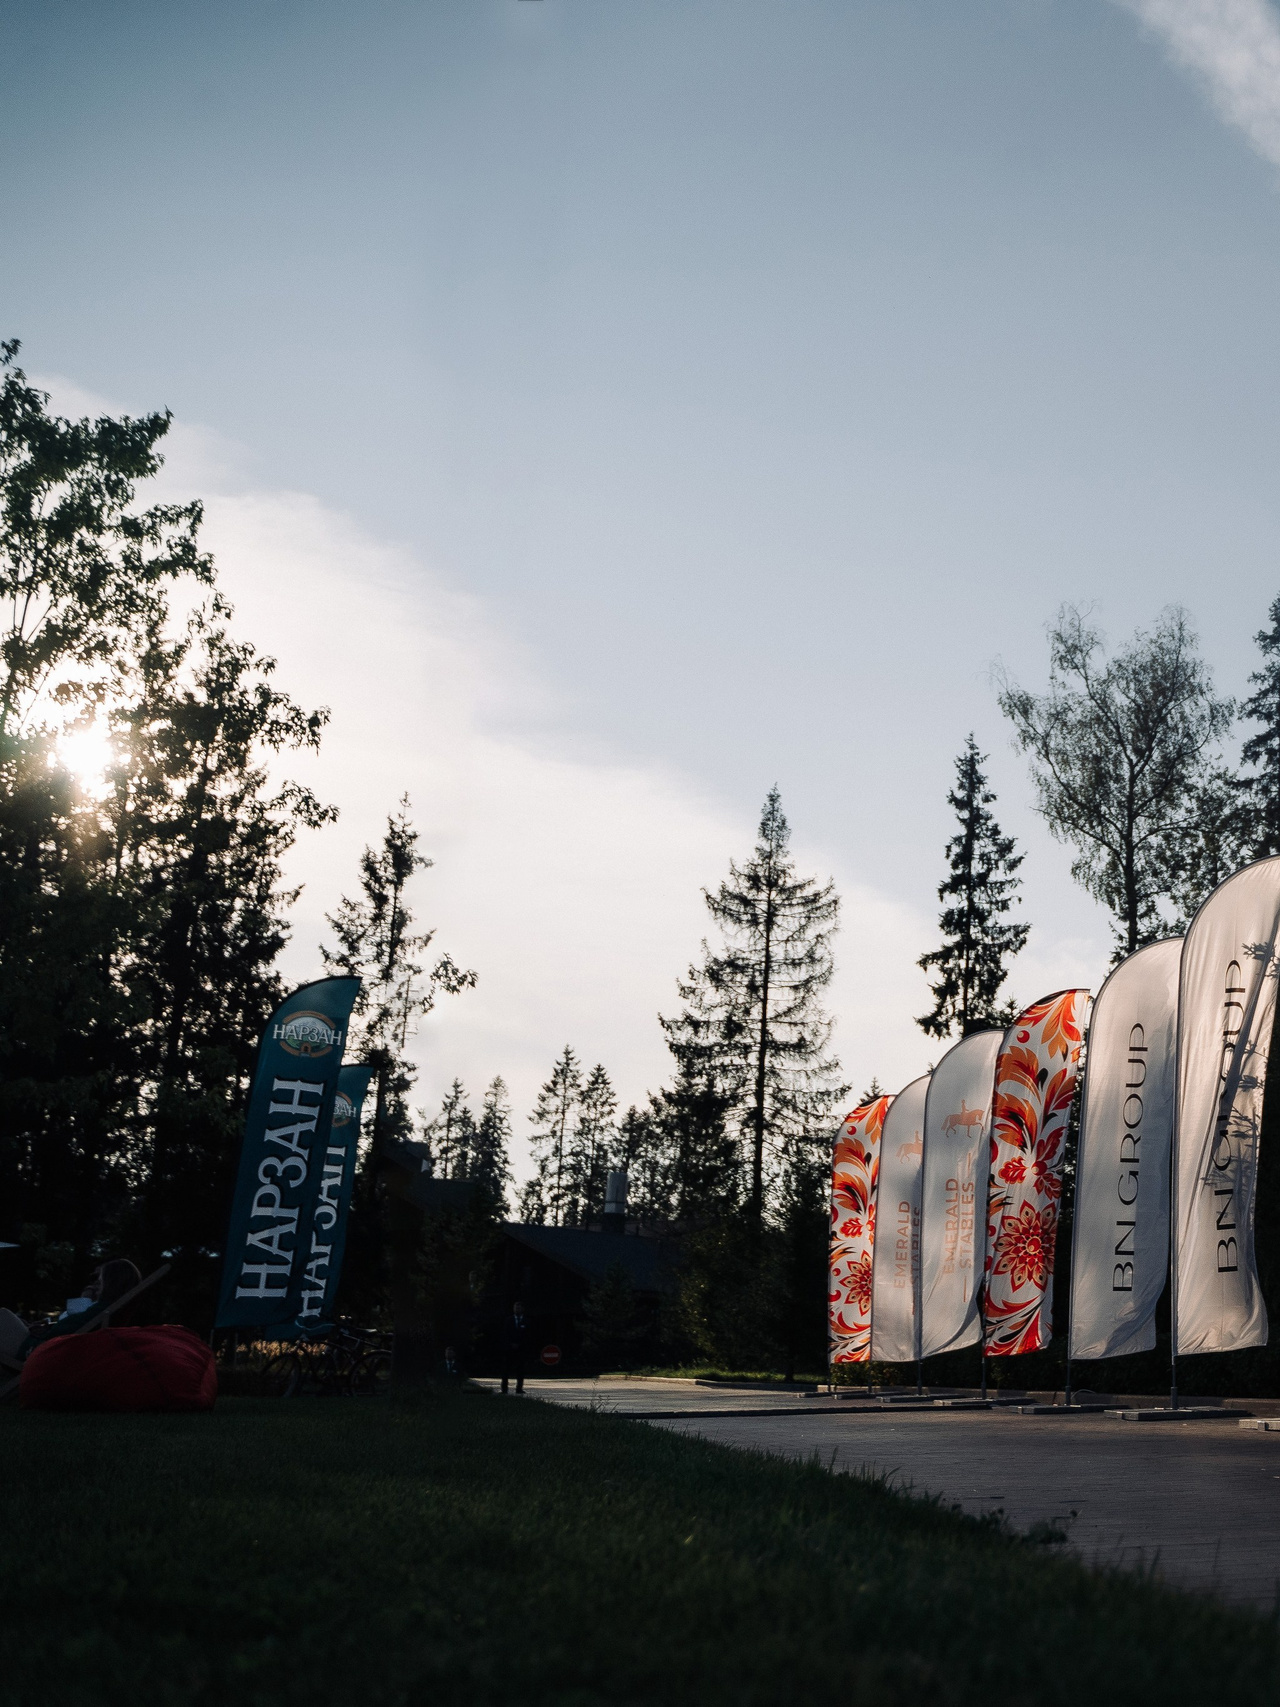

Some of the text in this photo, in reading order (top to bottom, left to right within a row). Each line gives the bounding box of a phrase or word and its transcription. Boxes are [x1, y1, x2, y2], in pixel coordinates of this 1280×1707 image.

[272, 1024, 342, 1046] НАРЗАН
[235, 1076, 325, 1300] НАРЗАН
[1112, 1022, 1149, 1292] BN GROUP
[894, 1201, 910, 1288] EMERALD
[944, 1178, 959, 1274] EMERALD
[960, 1181, 974, 1268] STABLES
[1213, 1187, 1239, 1274] BN
